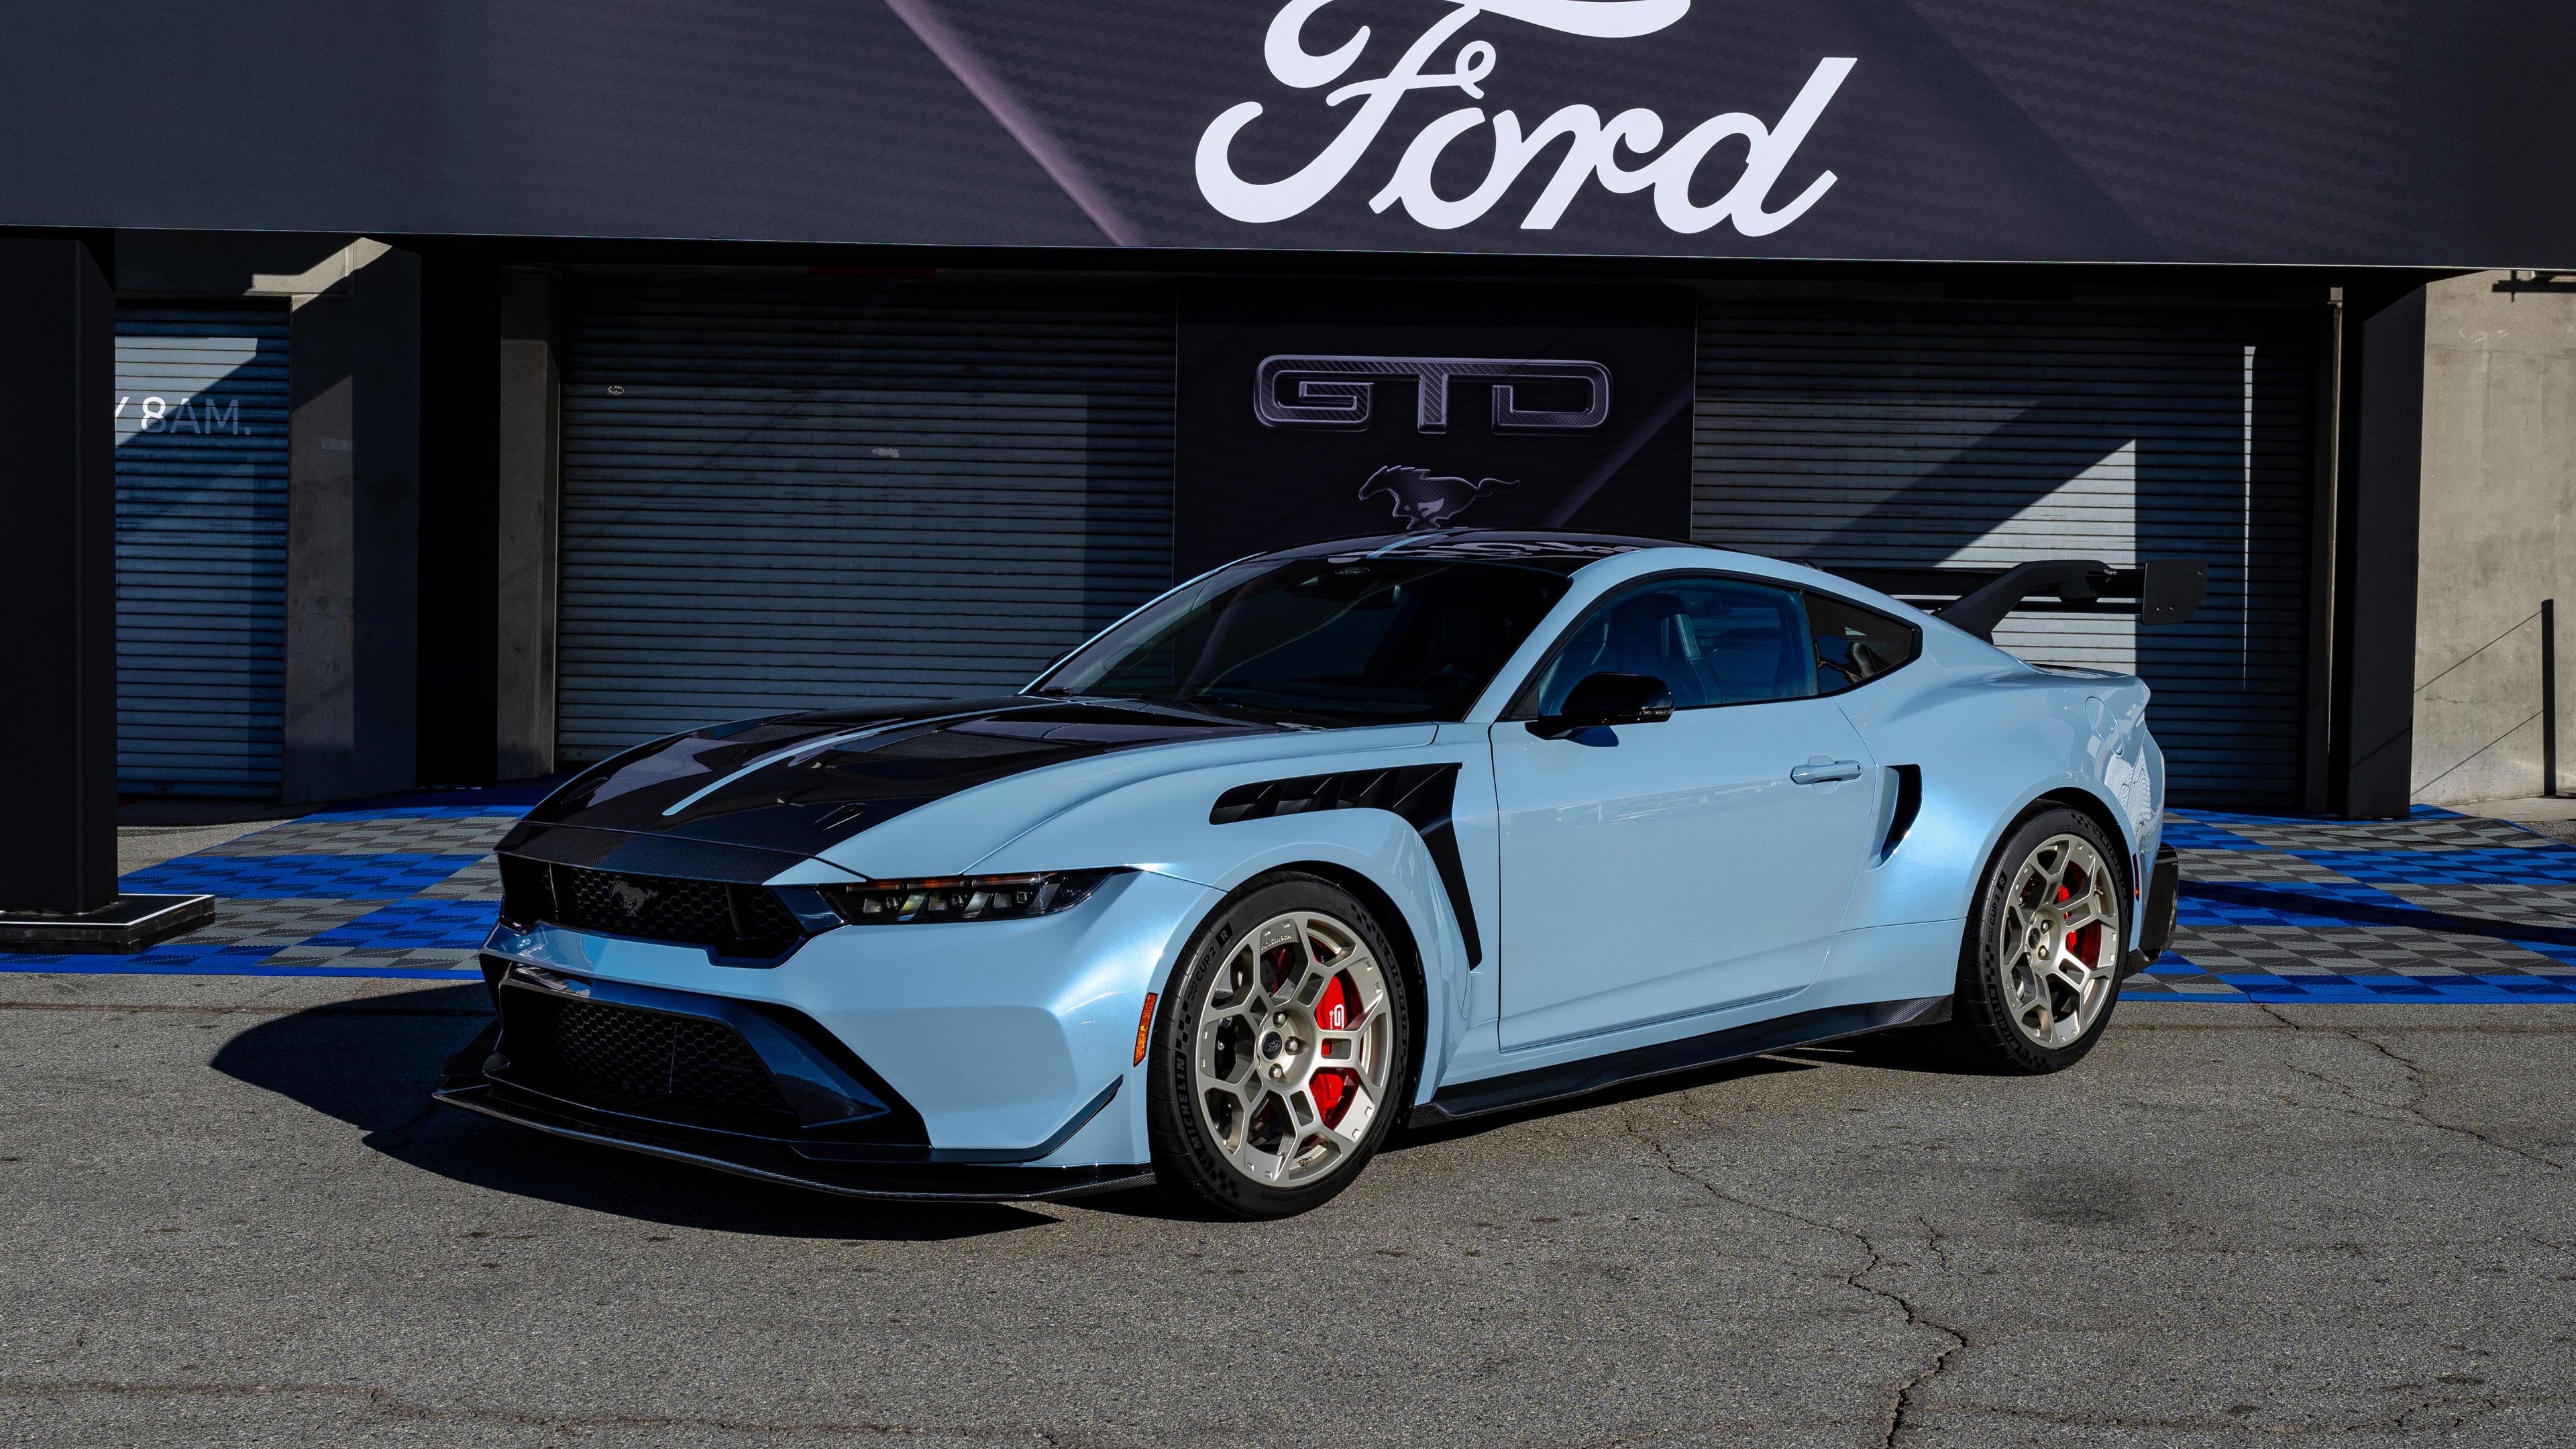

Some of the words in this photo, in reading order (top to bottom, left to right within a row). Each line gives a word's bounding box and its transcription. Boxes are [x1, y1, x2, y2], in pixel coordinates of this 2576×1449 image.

[1195, 0, 1858, 237] Ford
[141, 396, 251, 435] 8AM.
[1254, 354, 1612, 437] GTD
[1990, 902, 1998, 926] CUP
[1196, 954, 1210, 981] CUP
[1210, 946, 1217, 958] 2
[1220, 929, 1229, 942] R
[1187, 981, 1196, 1000] PILOT
[1386, 953, 1407, 1040] MICHELIN
[1990, 988, 2020, 1050] MICHELIN
[1177, 1057, 1203, 1150] MICHELIN
